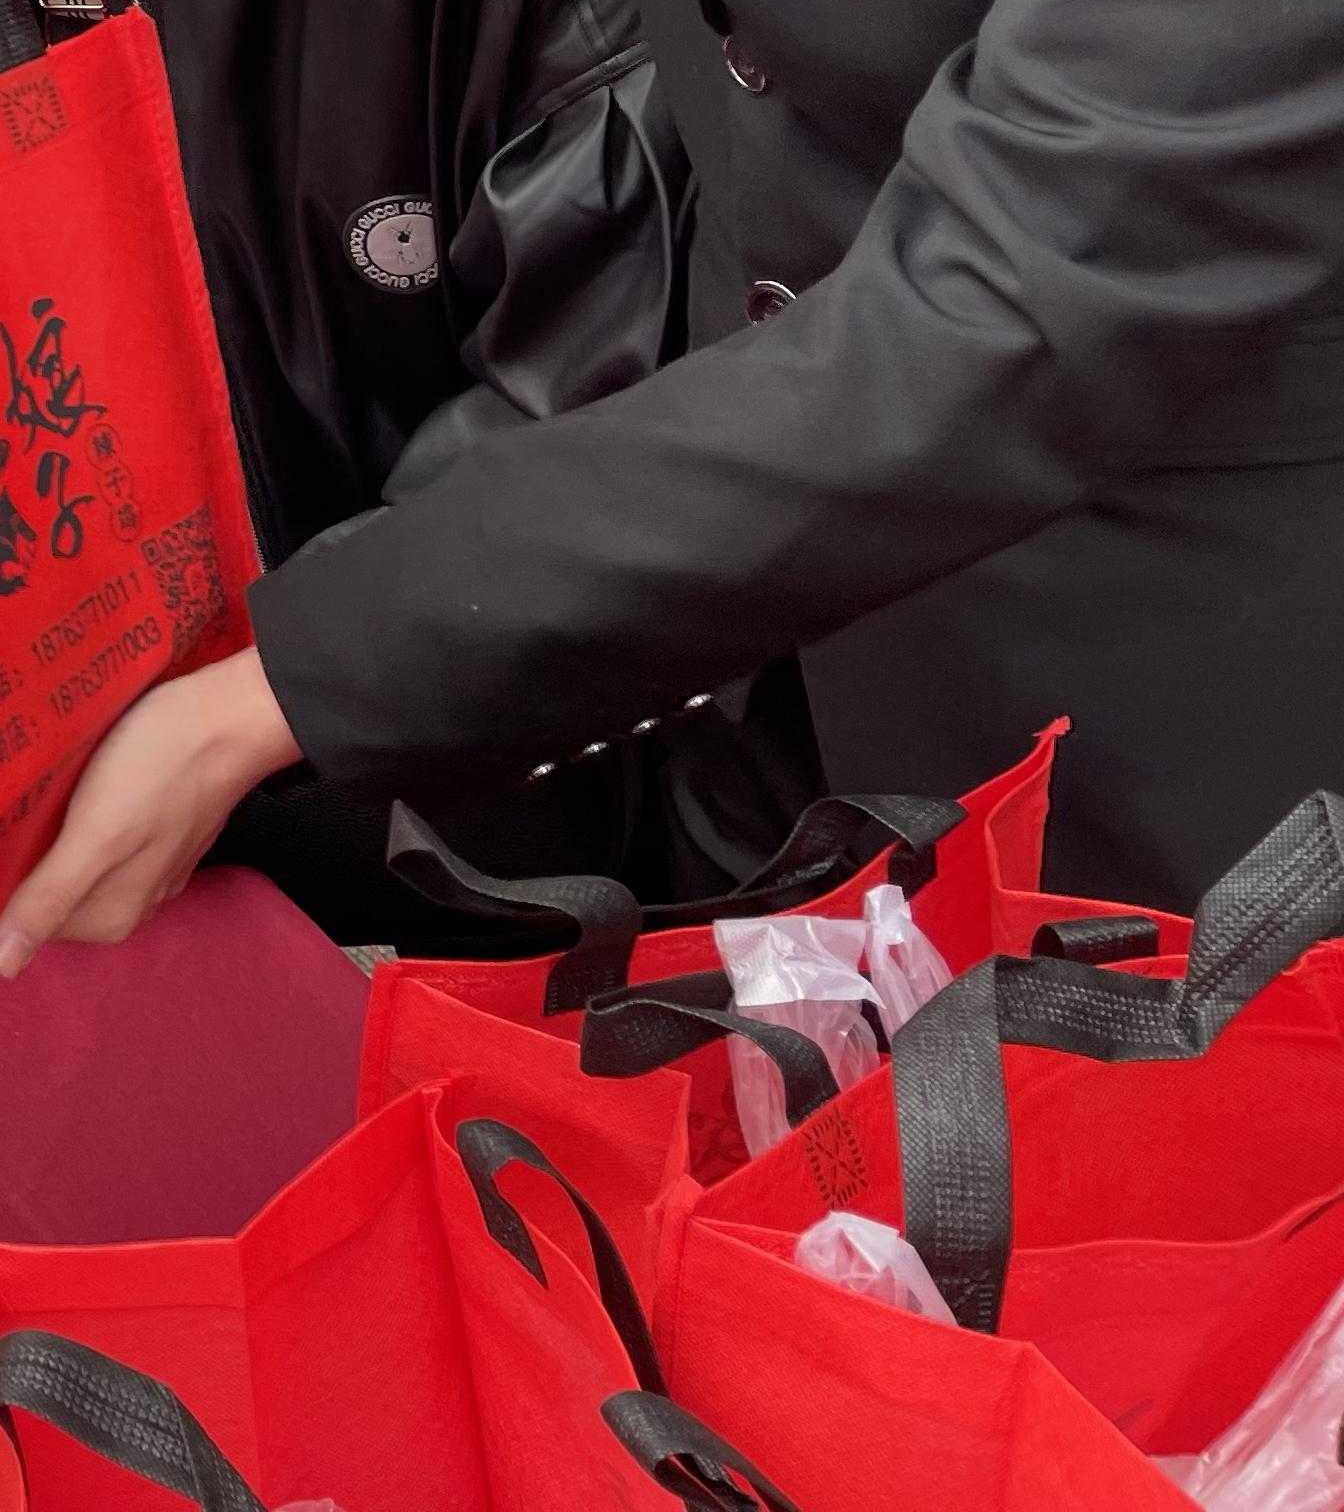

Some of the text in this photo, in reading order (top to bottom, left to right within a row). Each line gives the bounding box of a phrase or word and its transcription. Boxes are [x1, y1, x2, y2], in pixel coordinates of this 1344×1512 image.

[357, 202, 400, 229] GUCCI
[349, 227, 369, 267] GUCCI
[363, 264, 411, 288] GUCCI
[49, 615, 162, 720] 18763771003
